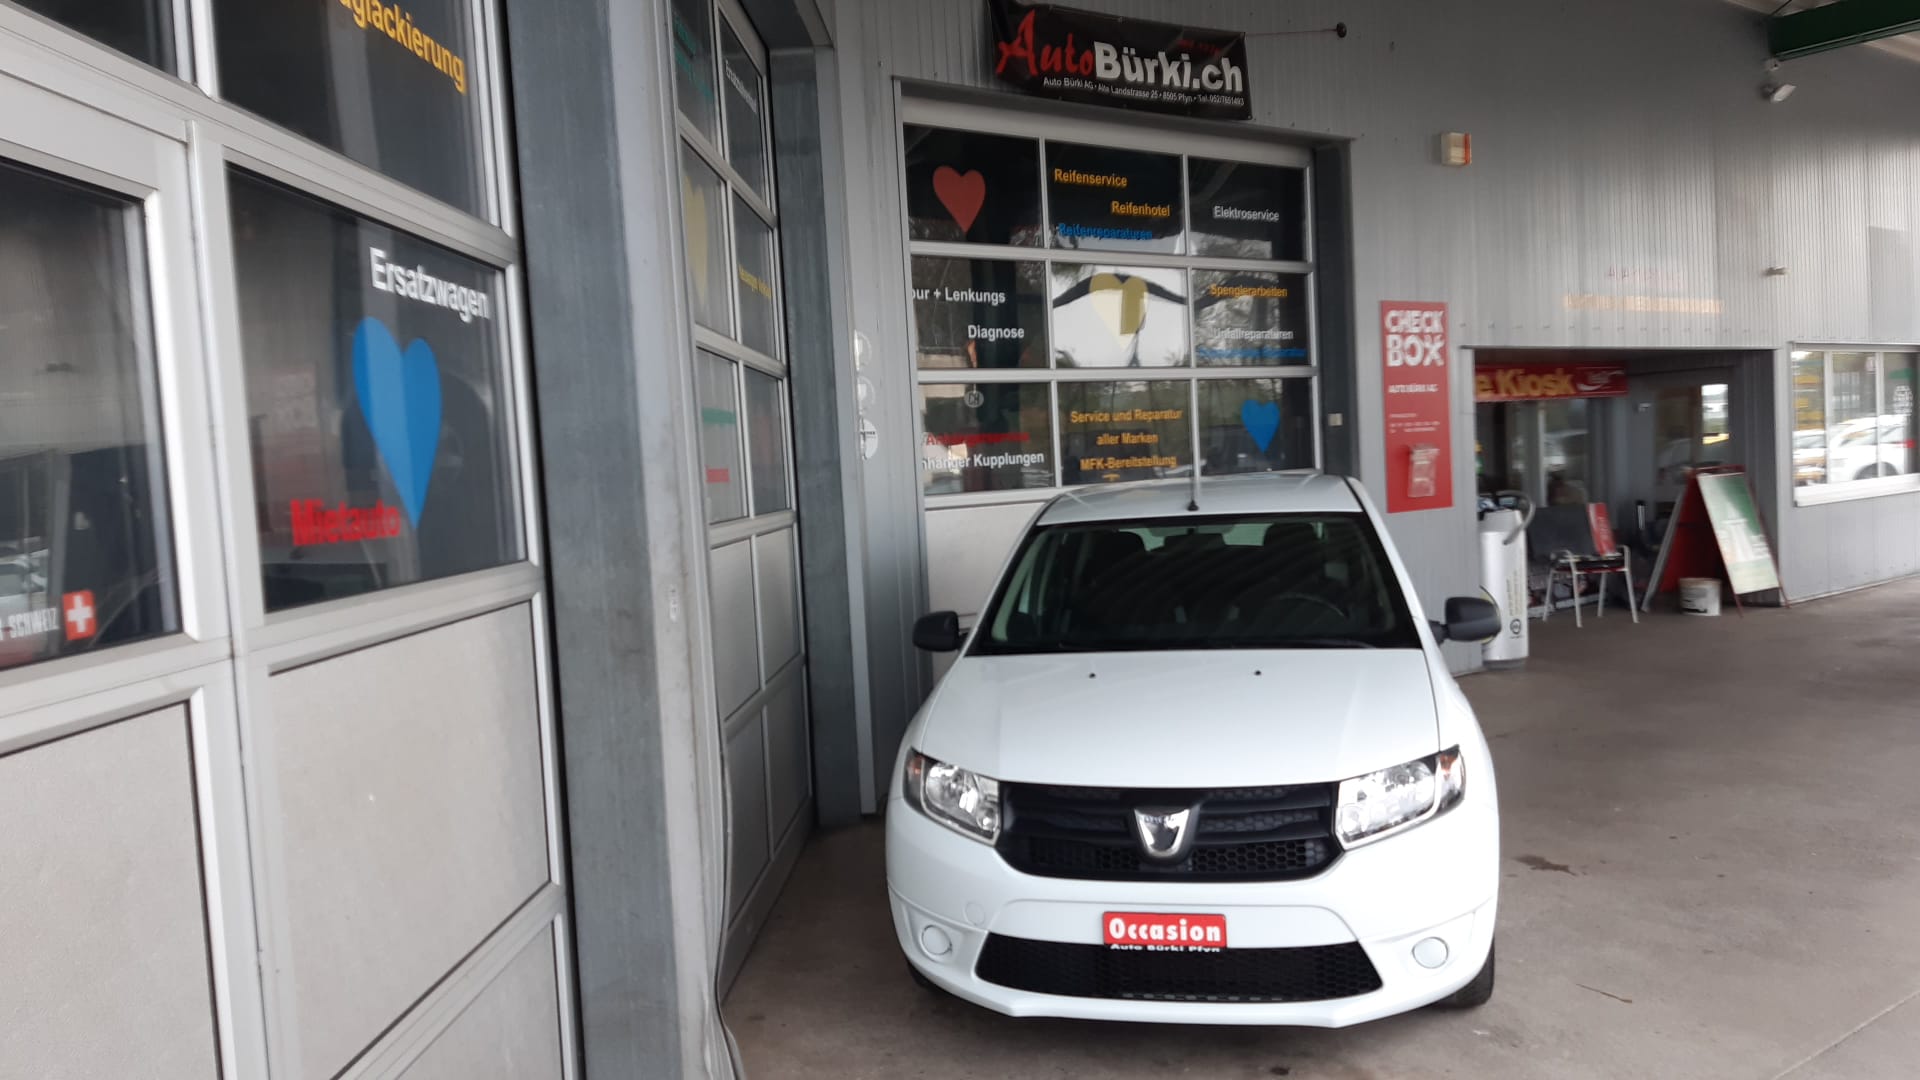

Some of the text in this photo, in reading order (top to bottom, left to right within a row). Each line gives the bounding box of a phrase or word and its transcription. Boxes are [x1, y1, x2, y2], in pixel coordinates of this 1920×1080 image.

[1043, 76, 1062, 87] Auto
[1084, 80, 1094, 89] AG
[1111, 85, 1150, 98] Landstrasse
[1054, 168, 1127, 188] Reifenservice
[1111, 200, 1170, 217] Reifenhotel
[1214, 205, 1279, 222] Elektroservice
[369, 246, 489, 324] Ersatzwagen
[945, 286, 1006, 306] Lenkungs
[1384, 309, 1445, 333] CHECK
[967, 324, 1024, 342] Diagnose
[1386, 334, 1445, 366] BOX
[1496, 368, 1576, 396] Kiosk
[1070, 409, 1183, 423] Service und Reparatur
[1096, 432, 1158, 445] aller Marken
[973, 452, 1044, 470] Kupplungen
[290, 498, 400, 546] Mietauto
[1109, 917, 1221, 942] Occasion
[1110, 943, 1143, 951] Auto
